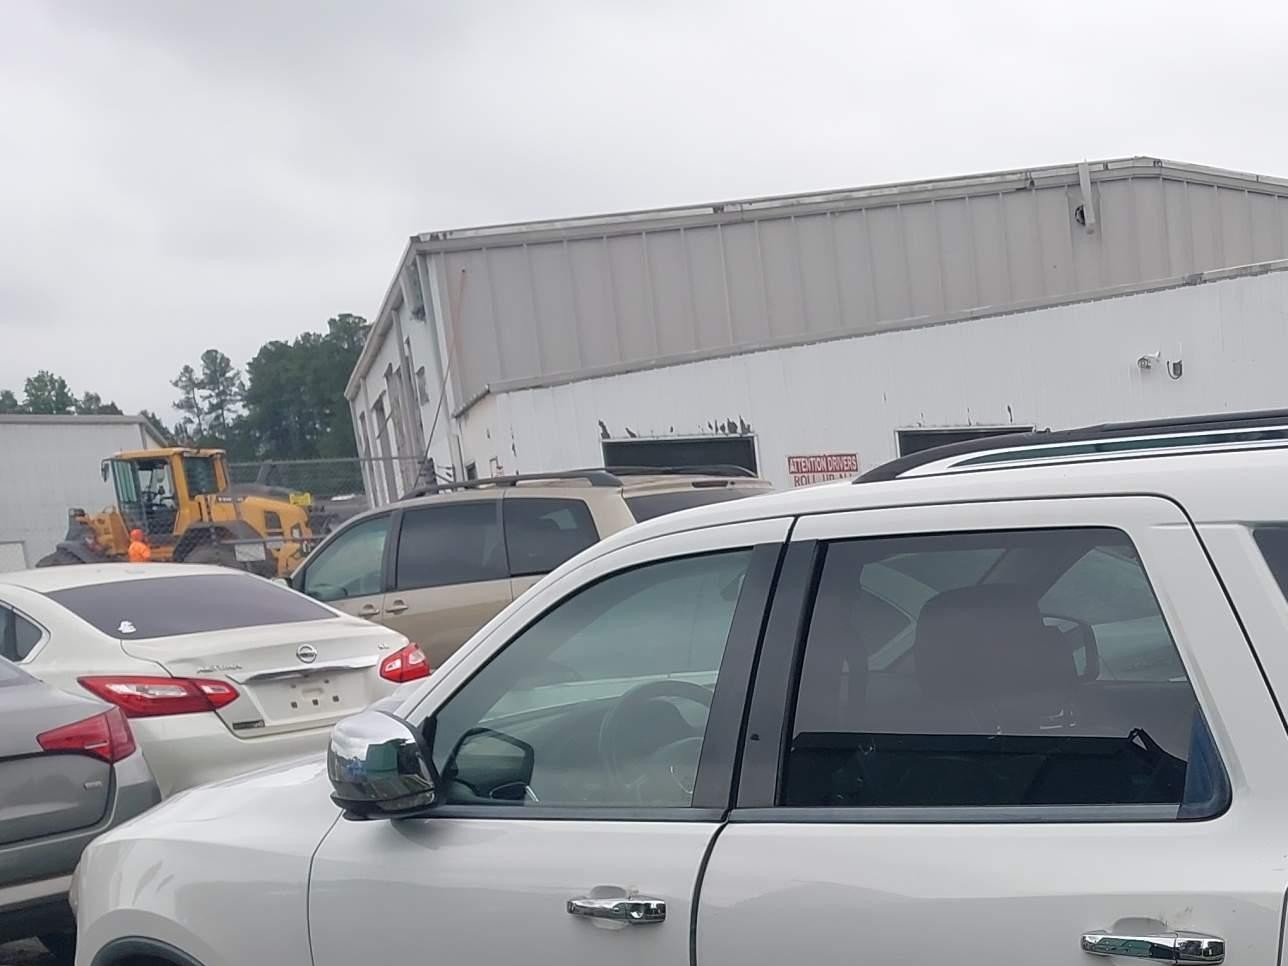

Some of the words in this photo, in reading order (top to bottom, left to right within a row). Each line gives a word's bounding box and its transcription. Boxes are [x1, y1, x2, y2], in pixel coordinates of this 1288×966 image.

[790, 456, 827, 473] ATTENTION
[828, 455, 857, 472] DRIVERS
[794, 474, 816, 487] ROLL
